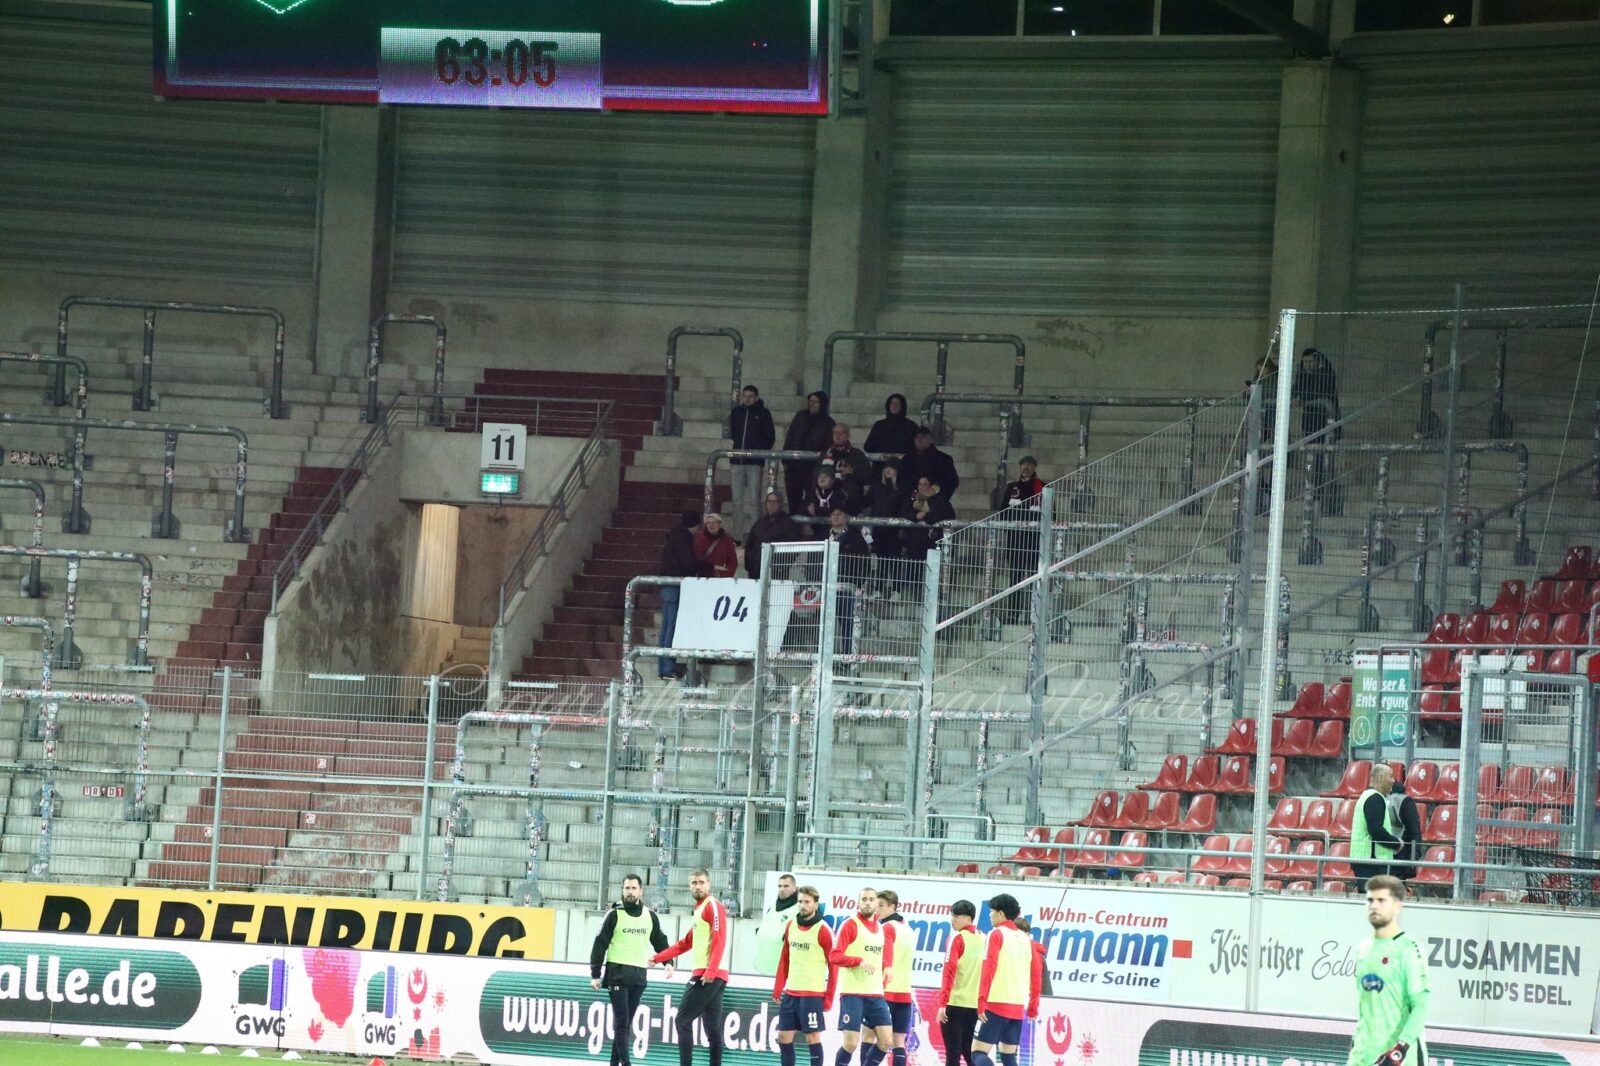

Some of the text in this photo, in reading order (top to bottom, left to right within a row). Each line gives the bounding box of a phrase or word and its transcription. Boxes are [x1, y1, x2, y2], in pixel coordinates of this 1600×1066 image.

[435, 36, 559, 88] 63:05
[491, 434, 515, 461] 11
[713, 594, 748, 622] 04
[1362, 677, 1407, 692] Waser &
[1355, 693, 1409, 711] Entsrgung
[1039, 906, 1168, 928] Wohn-Centrum
[1209, 928, 1304, 978] Kösritzer
[1427, 936, 1581, 977] ZUSAMMEN
[912, 957, 944, 974] line
[1068, 968, 1098, 983] der
[1102, 971, 1161, 988] Saline
[1458, 979, 1572, 1006] WIRD'S EDEL.
[236, 1014, 286, 1038] GWG
[807, 1012, 819, 1025] 11
[364, 1023, 396, 1046] GWG
